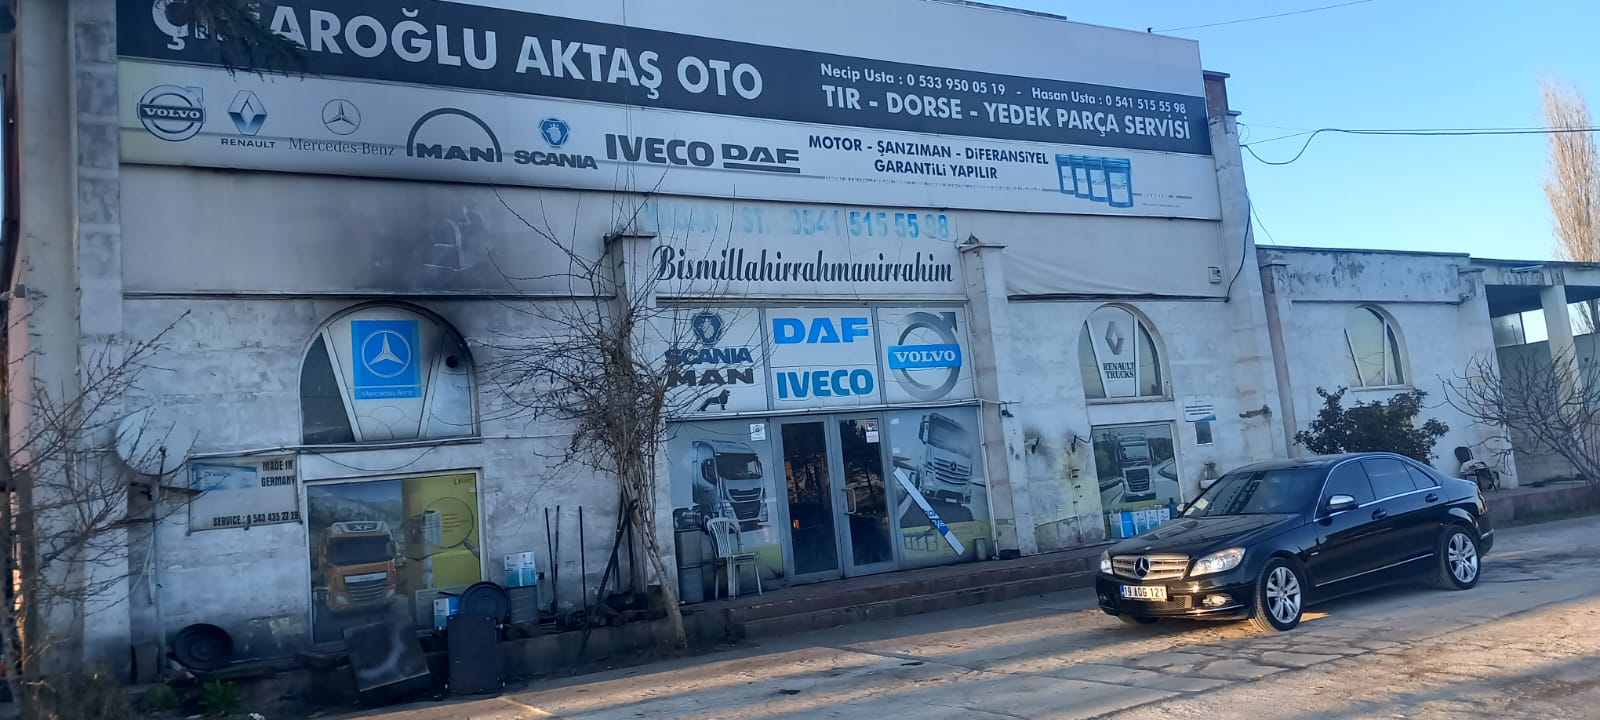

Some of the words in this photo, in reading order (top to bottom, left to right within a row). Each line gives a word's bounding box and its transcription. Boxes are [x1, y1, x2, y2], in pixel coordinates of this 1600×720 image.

[515, 35, 662, 100] AKTAŞ
[677, 55, 763, 100] OTO
[820, 63, 860, 83] Necip
[865, 69, 894, 85] Usta
[906, 74, 914, 87] 0
[919, 75, 942, 89] 533
[946, 78, 968, 92] 950
[972, 81, 987, 94] 05
[991, 83, 1005, 95] 19
[1032, 87, 1067, 102] Hasan
[1071, 91, 1095, 104] Usta
[1105, 95, 1112, 107] 0
[1115, 96, 1133, 108] 541
[1138, 99, 1156, 111] 515
[1159, 101, 1171, 113] 55
[1173, 102, 1186, 114] 98
[143, 106, 200, 119] VOLVO
[821, 84, 861, 110] TIR
[886, 92, 962, 120] DORSE
[983, 101, 1051, 127] YEDEK
[1056, 108, 1119, 137] PARÇA
[1124, 114, 1190, 140] SERVİSİ
[221, 137, 277, 149] RENAULT
[288, 137, 395, 157] Mercedes-Benz
[415, 143, 495, 163] MAN
[605, 133, 715, 167] IVECO
[808, 135, 862, 152] MOTOR
[877, 140, 951, 158] ŞANZIMAN
[513, 149, 598, 170] SCANIA
[721, 143, 800, 165] DAF
[949, 164, 998, 180] YAPILIR
[849, 211, 888, 238] 515
[894, 211, 921, 239] 55
[652, 245, 953, 283] Bismillahirrahmanirrahim
[771, 316, 870, 345] DAF
[664, 347, 754, 366] SCANIA
[893, 350, 956, 363] VOLVO
[667, 368, 755, 388] MAN
[776, 368, 874, 399] IVECO
[1105, 370, 1135, 380] TRUCKS
[262, 460, 283, 472] MADE
[285, 460, 294, 470] IN
[261, 475, 296, 488] GERMANY
[213, 515, 241, 527] SERVICE
[351, 523, 376, 531] XF
[1150, 588, 1164, 598] 121
